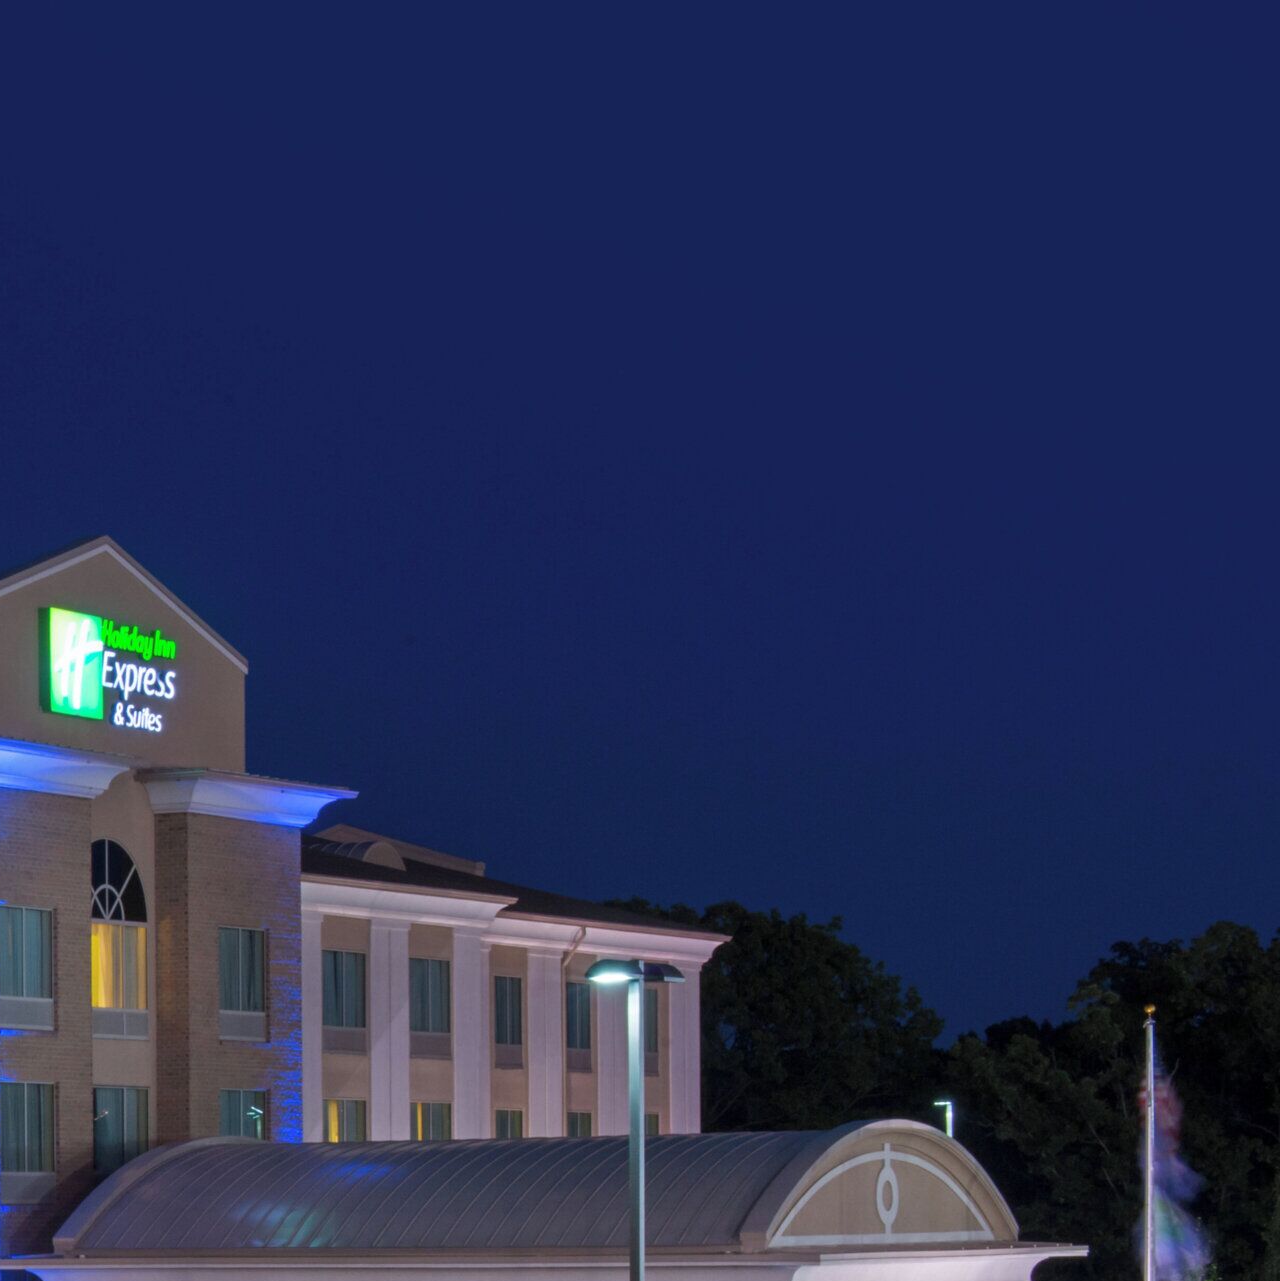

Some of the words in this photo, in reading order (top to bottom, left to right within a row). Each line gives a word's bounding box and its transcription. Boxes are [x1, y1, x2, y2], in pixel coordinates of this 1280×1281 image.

[101, 619, 154, 660] Holiday
[153, 630, 176, 659] Inn
[102, 651, 176, 700] Express
[114, 702, 124, 726] &
[126, 705, 162, 732] Suites
